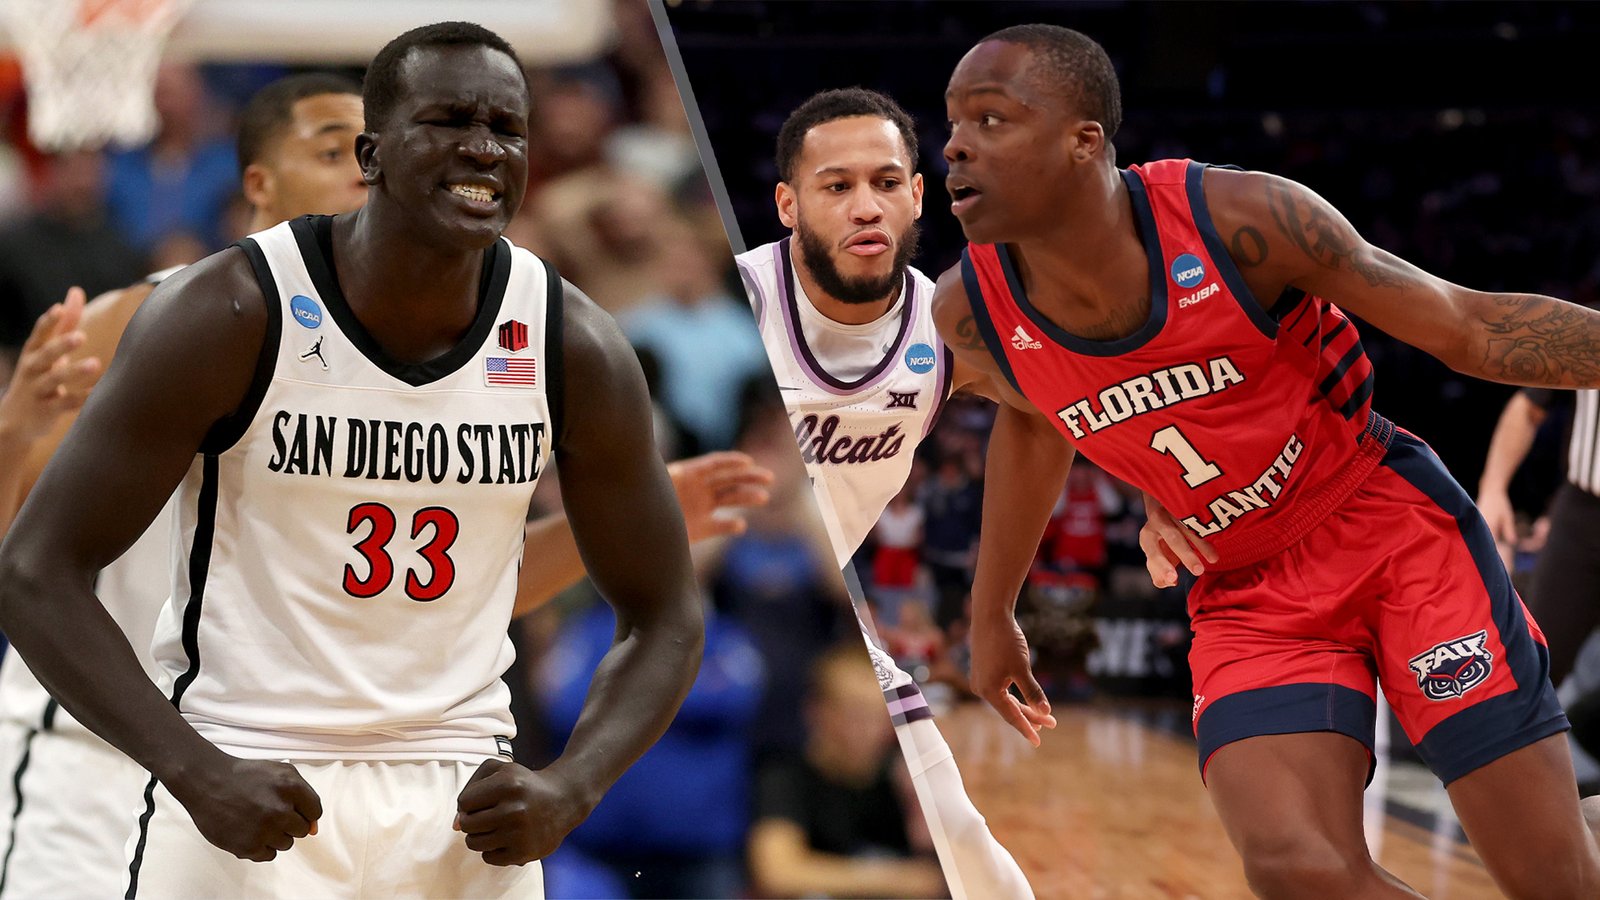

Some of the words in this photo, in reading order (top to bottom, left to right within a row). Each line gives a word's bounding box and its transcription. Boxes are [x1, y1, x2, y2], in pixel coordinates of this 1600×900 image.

[1176, 265, 1204, 283] NCAA
[294, 307, 320, 323] NCAA
[909, 356, 936, 367] NCAA
[886, 390, 920, 410] XII
[1056, 356, 1246, 440] FLORIDA
[267, 409, 338, 478] SAN
[342, 417, 450, 484] DIEGO
[456, 421, 545, 485] STATE
[796, 413, 906, 465] ldcats
[1150, 423, 1223, 490] 1
[1180, 432, 1306, 539] LANTIC
[341, 500, 461, 603] 33
[1408, 631, 1487, 684] FAU
